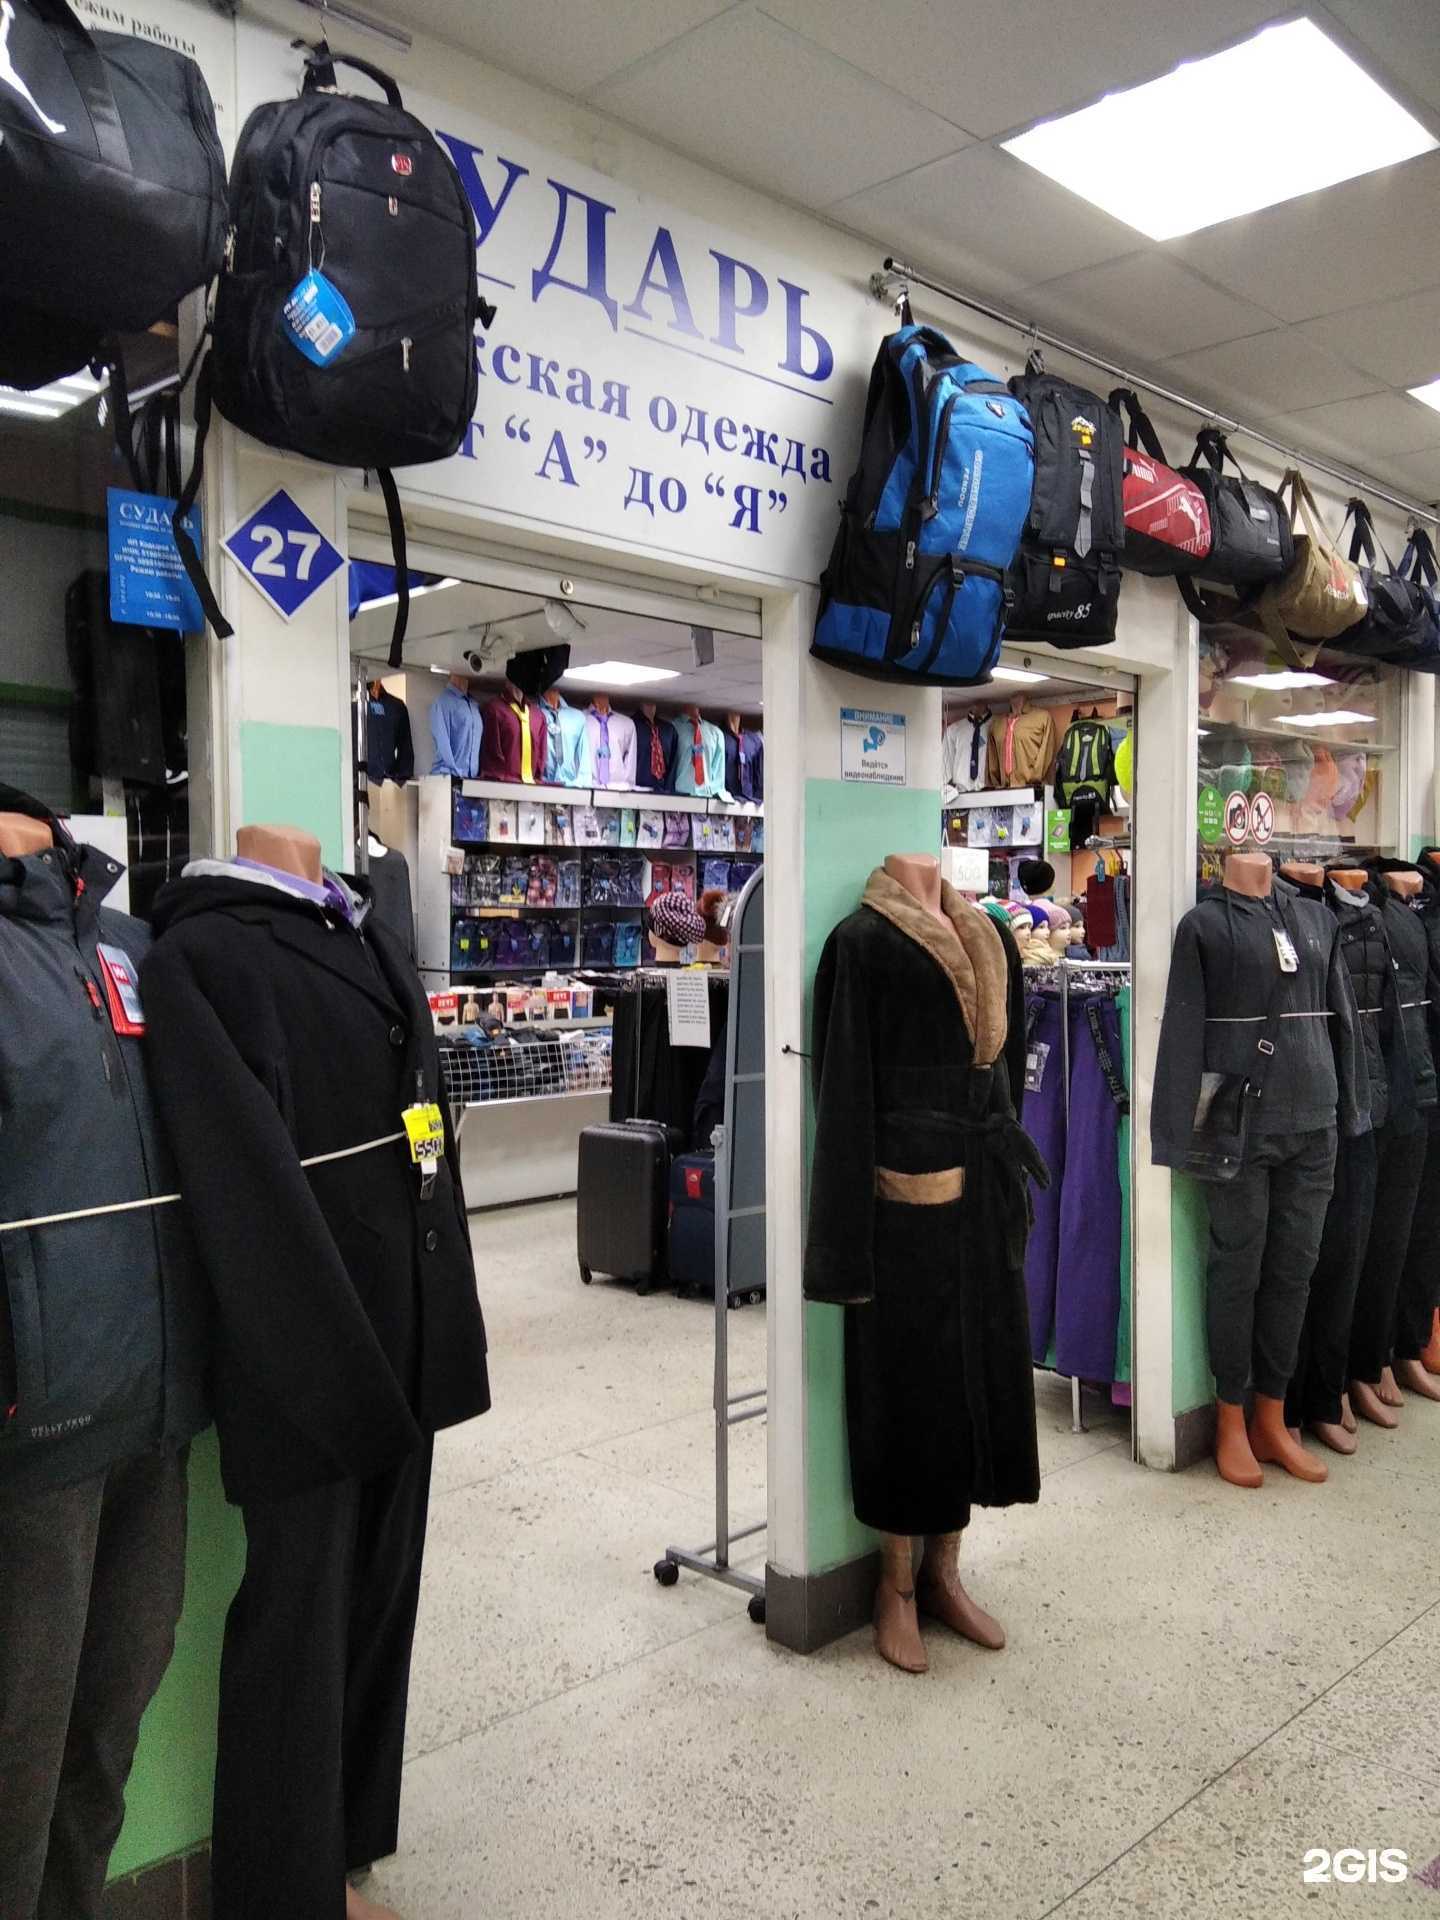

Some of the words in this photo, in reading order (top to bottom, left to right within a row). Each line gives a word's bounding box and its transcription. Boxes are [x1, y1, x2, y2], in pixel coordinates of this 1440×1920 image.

[648, 395, 833, 485] одежда
[119, 503, 194, 529] СУДАЬ
[624, 465, 688, 517] до
[250, 524, 322, 581] 27
